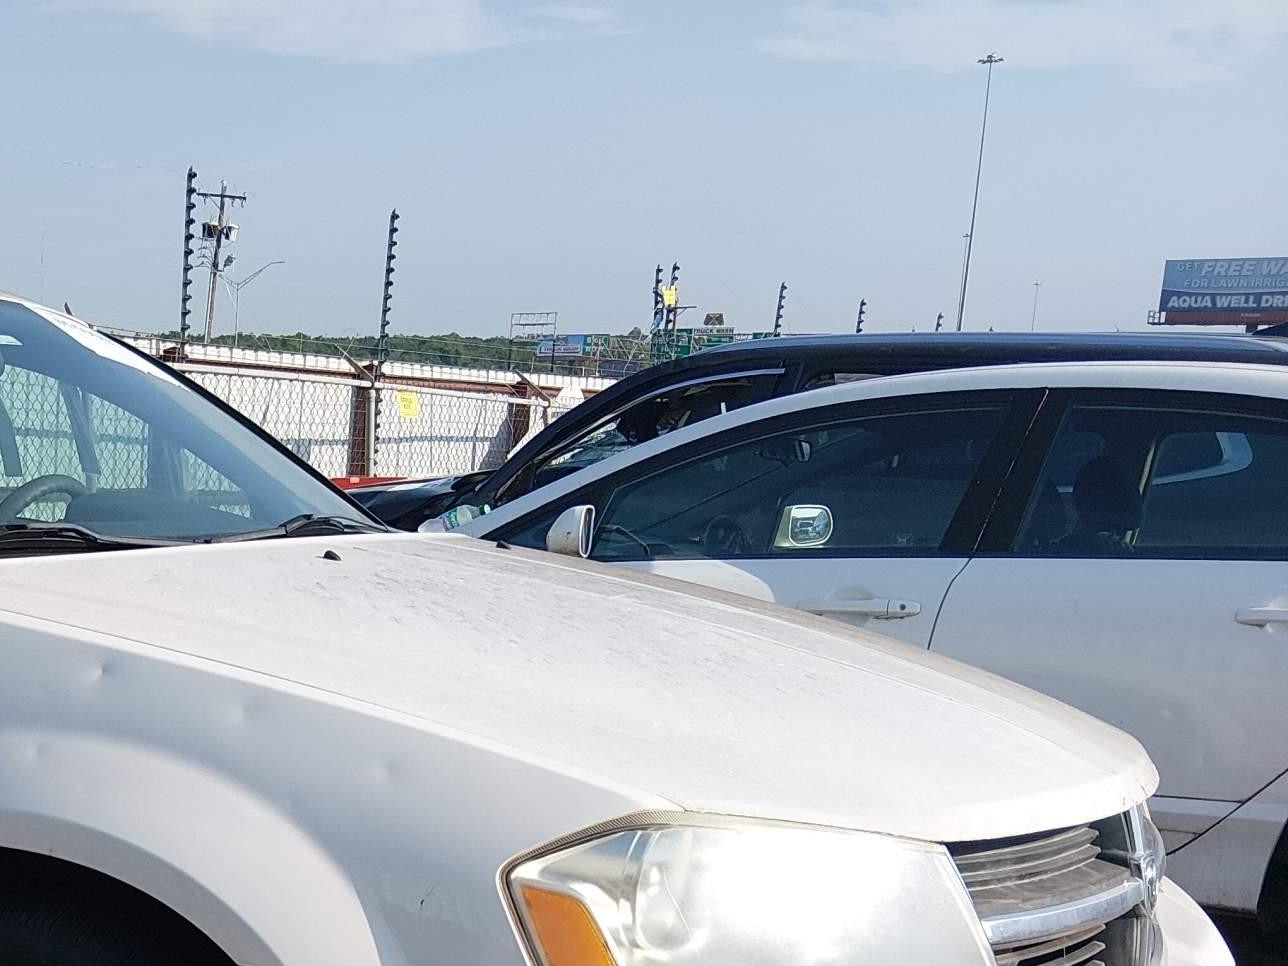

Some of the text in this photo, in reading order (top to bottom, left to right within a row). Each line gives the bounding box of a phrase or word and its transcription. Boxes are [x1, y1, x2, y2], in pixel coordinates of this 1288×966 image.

[1177, 262, 1200, 271] GET
[1201, 261, 1256, 276] FREE
[1184, 279, 1208, 288] FOR
[1212, 278, 1248, 288] LAWN
[1167, 295, 1212, 308] AQUA
[1215, 295, 1257, 308] WELL
